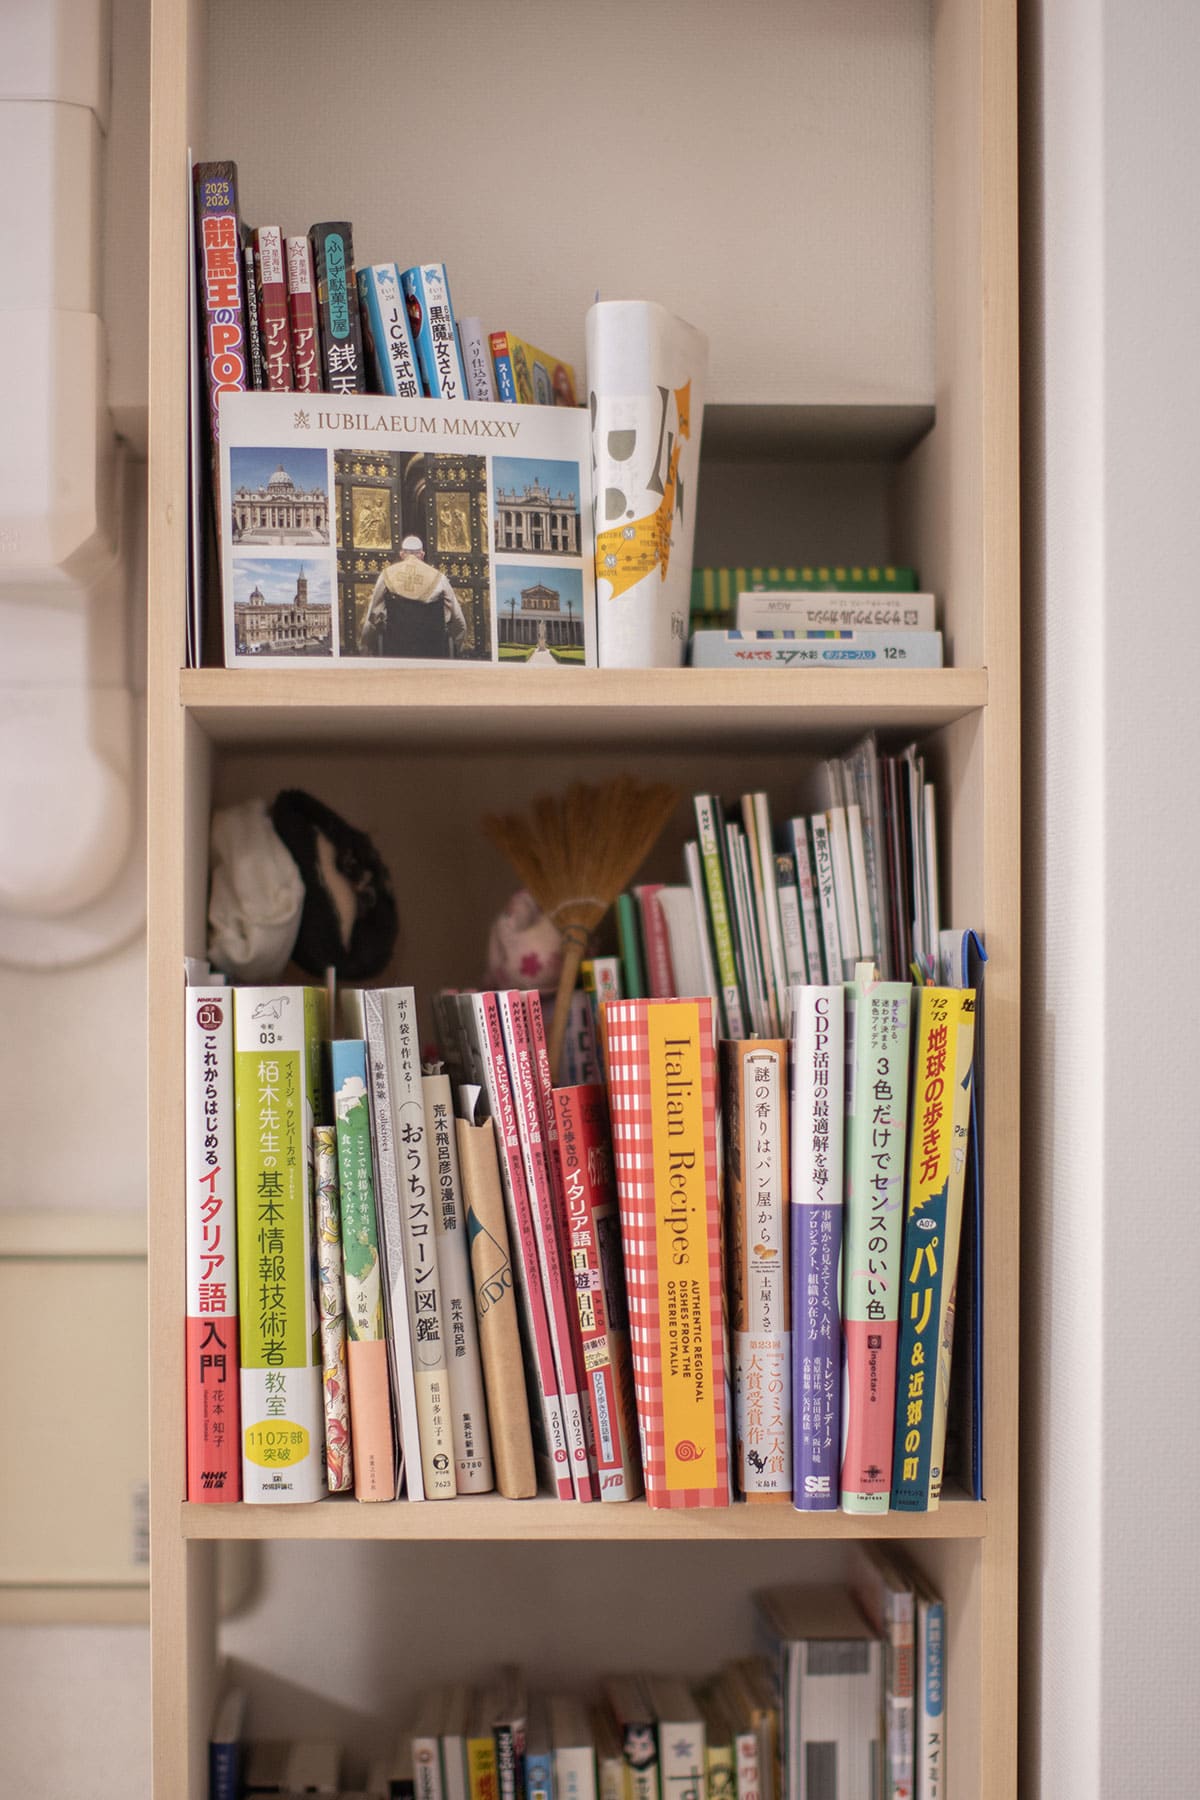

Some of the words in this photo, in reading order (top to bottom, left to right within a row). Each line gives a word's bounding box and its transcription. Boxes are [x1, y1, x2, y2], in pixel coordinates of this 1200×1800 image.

[205, 182, 229, 194] 2025
[206, 195, 230, 207] 2026
[262, 250, 273, 282] COMICS
[289, 260, 300, 293] COMICS
[328, 240, 348, 333] ふしぎ駄菓子屋
[390, 308, 418, 398] JC紫式部
[317, 412, 436, 435] IUBILAEUM
[443, 417, 520, 438] MMXXV
[814, 826, 833, 909] 東京カレンダー
[200, 1011, 221, 1024] DL
[871, 1000, 880, 1048] 配色アイデア
[880, 1000, 890, 1050] 迷わず決まる
[930, 999, 948, 1009] '12
[932, 1011, 948, 1022] '13
[398, 1000, 413, 1094] ポリ袋で作れる!
[664, 1036, 692, 1138] Italian
[812, 997, 830, 1202] CDP活用の最適解を導く
[920, 1024, 948, 1185] 地球の歩き方
[432, 1104, 457, 1231] 荒木飛呂彦の漫画術
[754, 1066, 772, 1243] 謎の香りはパン屋から
[664, 1150, 696, 1266] Recipes
[865, 1057, 894, 1320] 3色だけでセンスのいい色
[402, 1123, 440, 1342] おうちスコーン図鑑
[668, 1282, 676, 1328] OSTERIE
[680, 1280, 688, 1318] DISHES
[692, 1280, 702, 1344] AUTHENTIC
[759, 1276, 772, 1333] 土屋うさ
[451, 1299, 466, 1357] 荒木飛呂彦
[680, 1318, 690, 1350] FROM
[670, 1330, 678, 1376] D'ITALIA
[682, 1352, 691, 1378] THE
[692, 1347, 704, 1403] REGIONAL
[824, 1357, 834, 1448] トレジャーデータ
[249, 1432, 303, 1446] 110万部
[550, 1410, 562, 1448] 2025
[571, 1410, 583, 1446] 2025
[200, 1471, 228, 1480] NHK
[264, 1449, 290, 1462] 突破
[602, 1475, 623, 1490] JTB
[804, 1476, 830, 1492] SE
